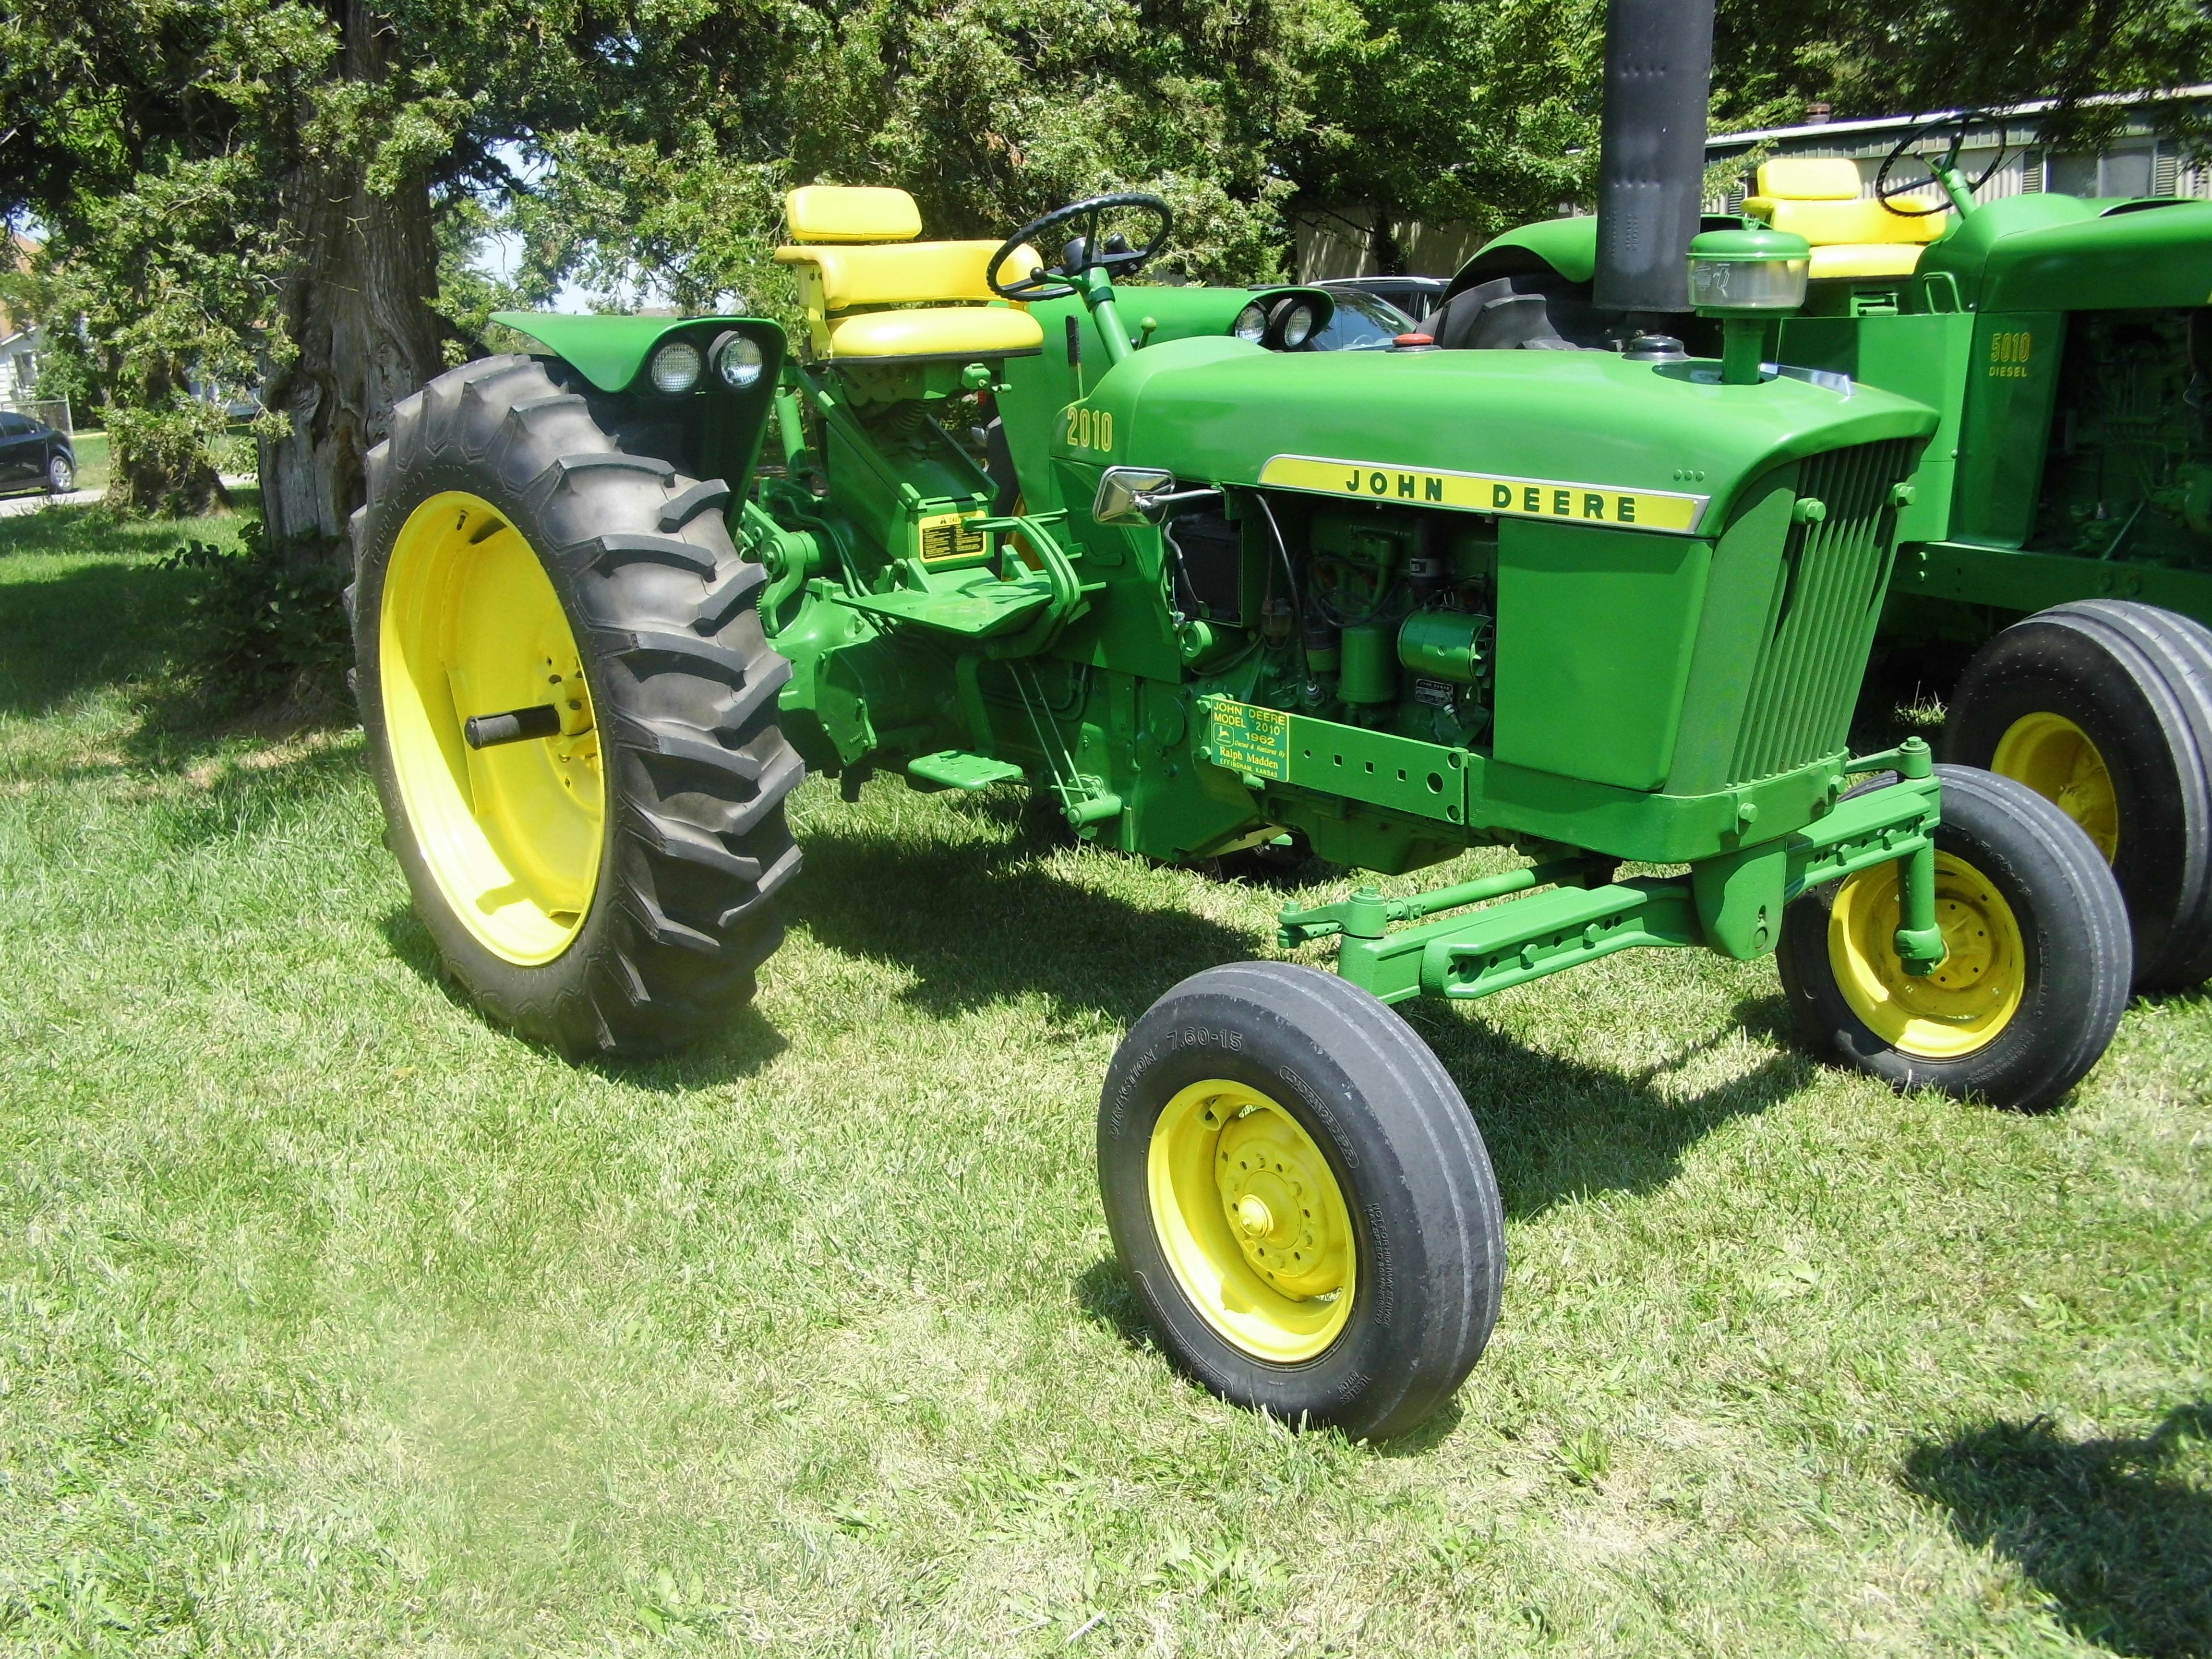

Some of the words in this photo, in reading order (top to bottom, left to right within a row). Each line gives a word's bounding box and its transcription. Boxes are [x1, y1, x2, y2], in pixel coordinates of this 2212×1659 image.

[1991, 332, 2031, 362] 5010
[1989, 366, 2028, 377] DIESEL
[1067, 407, 1112, 452] 2010
[1346, 469, 1443, 502] JOHN
[1493, 484, 1636, 522] DEERE
[1214, 701, 1242, 716] JOHN
[1249, 709, 1286, 725] DEERE
[1214, 712, 1247, 728] MODEL
[1234, 740, 1249, 748] Owned
[1256, 745, 1277, 755] Restored
[1278, 750, 1286, 758] By
[1244, 732, 1275, 746] 1962
[1220, 746, 1243, 761] Ralph
[1247, 752, 1278, 769] Madden
[1255, 767, 1278, 778] KANSAS
[1166, 1026, 1242, 1052] 7.60-15
[1285, 1070, 1307, 1093] LOAD
[1307, 1094, 1334, 1127] RANGE
[1372, 1202, 1385, 1224] NOT
[1379, 1225, 1390, 1247] FOR
[1382, 1247, 1395, 1291] HIGHWAY
[1382, 1291, 1394, 1330] SERVICE
[1337, 1370, 1359, 1394] NYLON
[1340, 1375, 1371, 1405] TUBELESS
